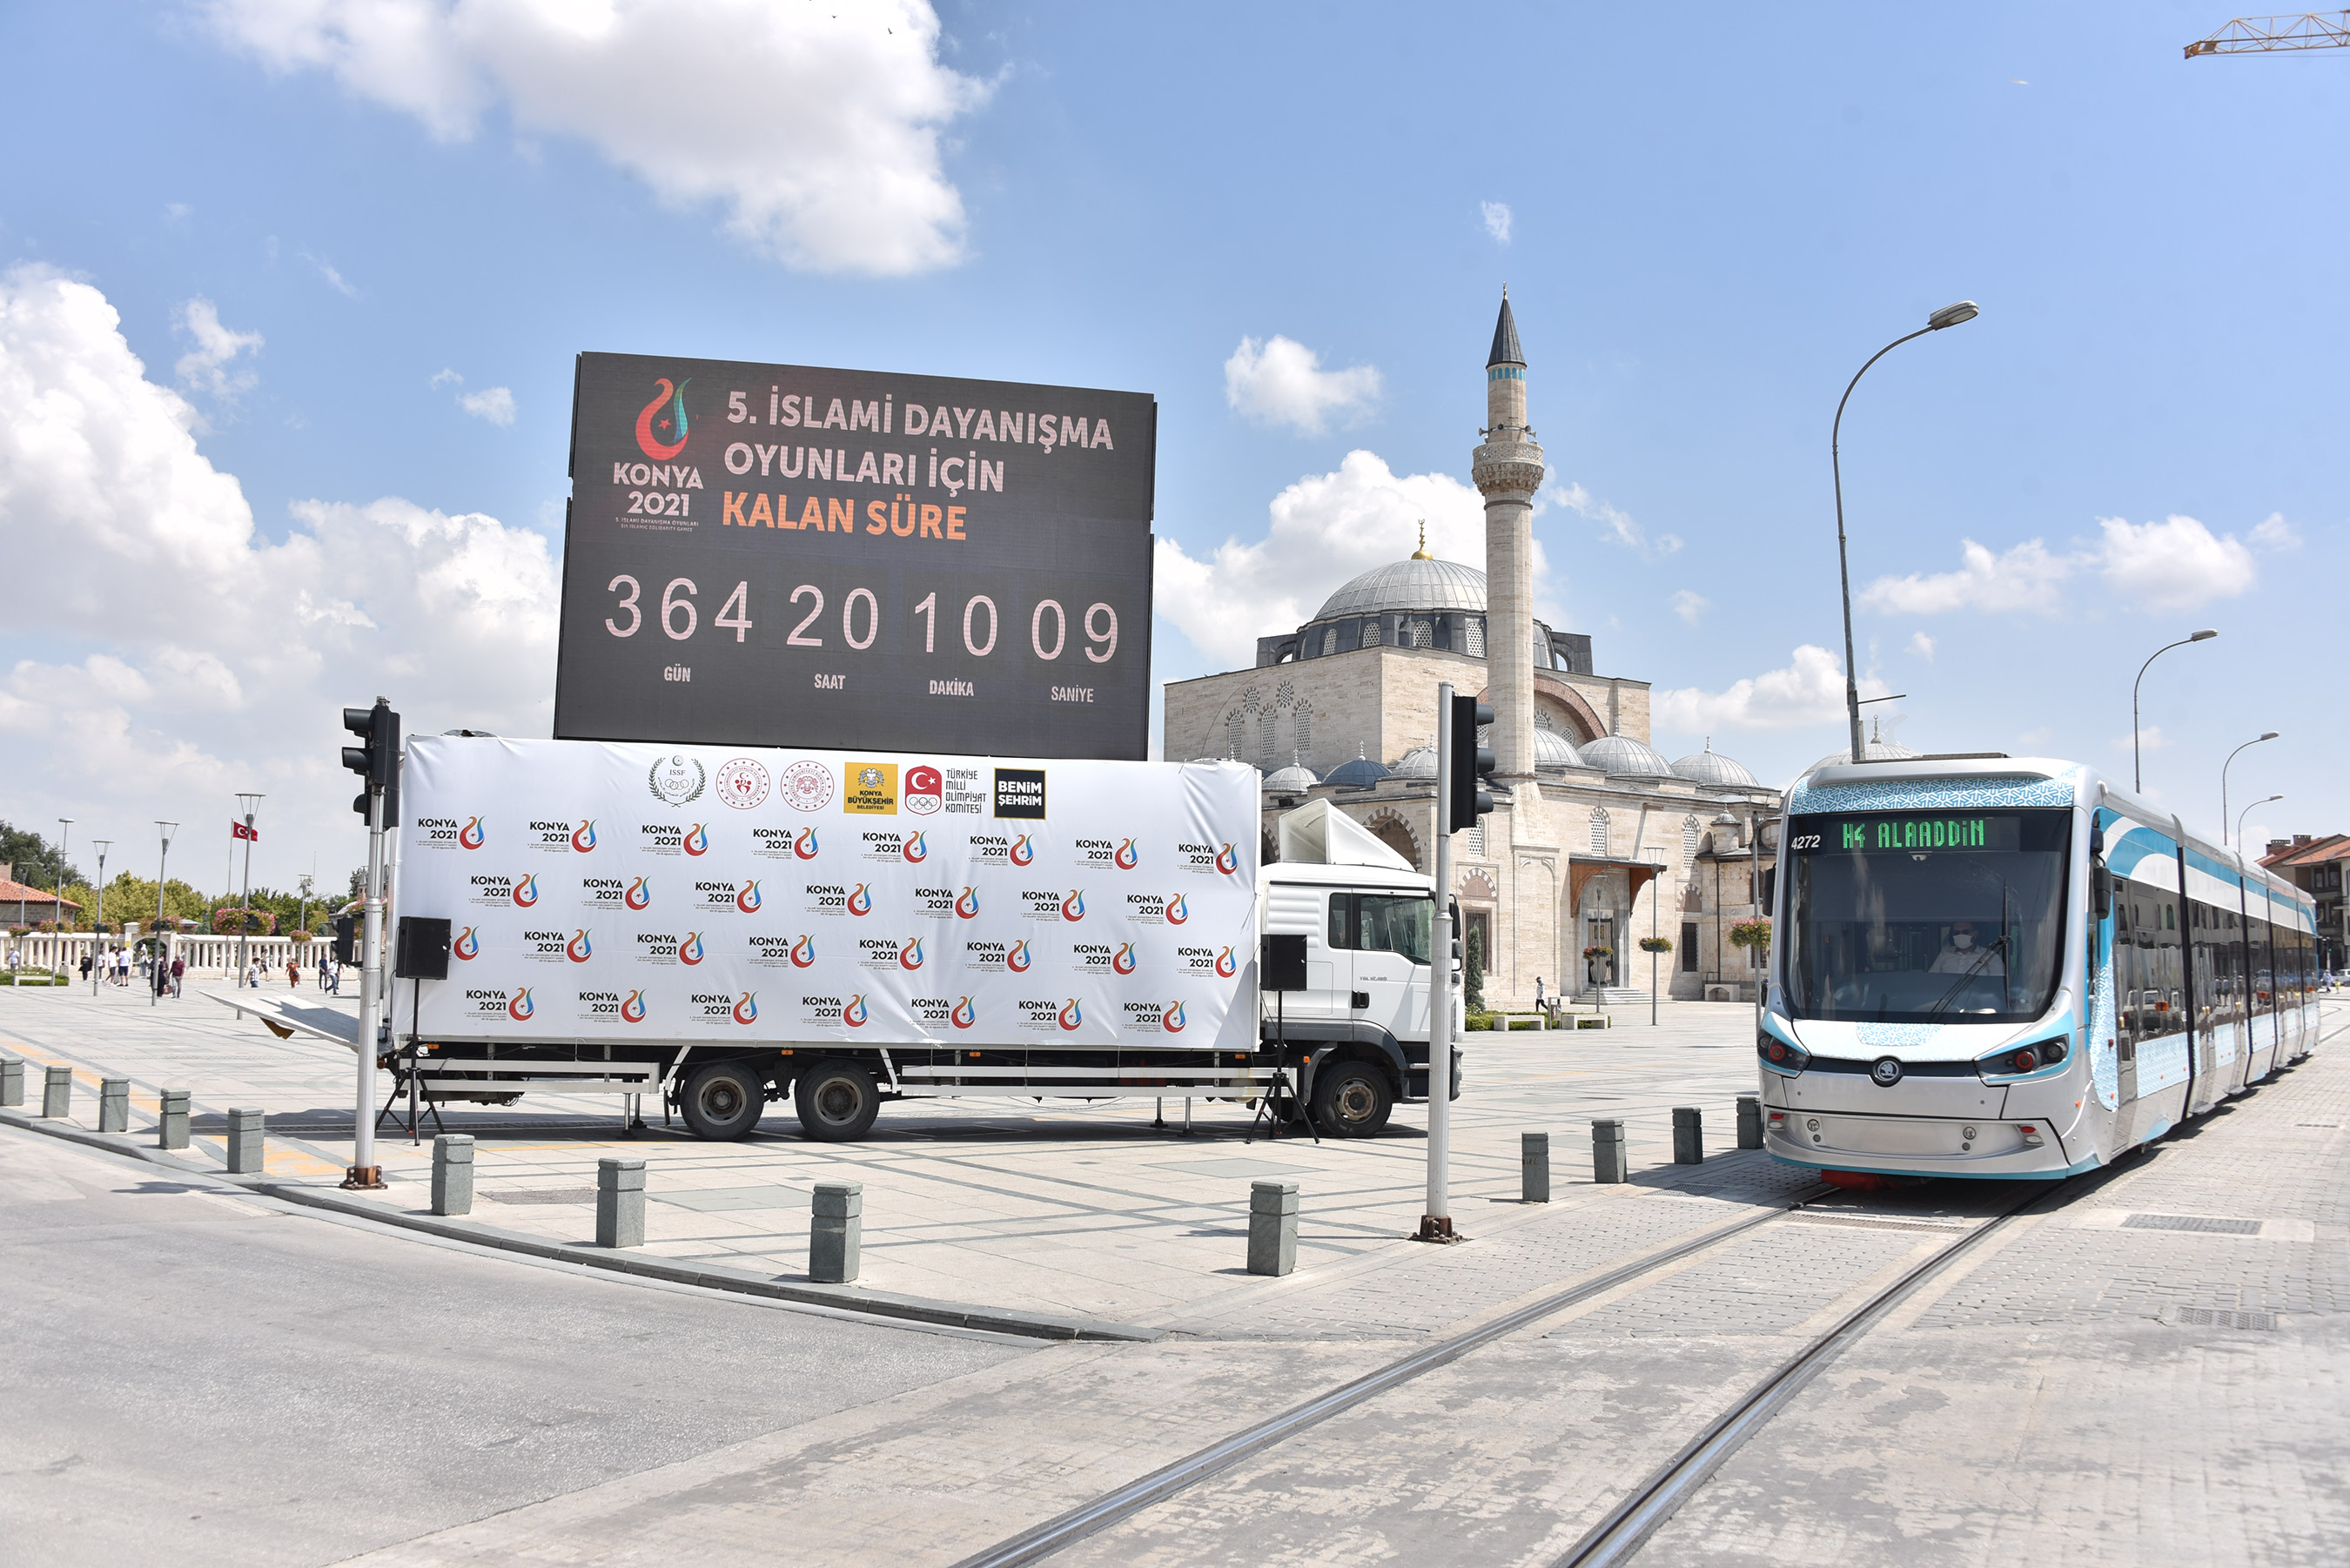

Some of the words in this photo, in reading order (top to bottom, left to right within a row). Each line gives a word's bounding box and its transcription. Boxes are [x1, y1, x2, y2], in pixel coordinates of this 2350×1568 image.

[727, 392, 756, 424] 5.
[769, 385, 892, 432] İSLAMİ
[905, 404, 1113, 454] DAYANIŞMA
[725, 442, 916, 486] OYUNLARI
[929, 448, 1004, 497] İÇİN
[613, 462, 703, 490] KONYA
[627, 491, 689, 516] 2021
[722, 492, 854, 533] KALAN
[866, 491, 966, 540] SÜRE
[787, 585, 878, 649] 20
[915, 593, 997, 656] 10
[1032, 600, 1118, 663] 09
[664, 664, 690, 681] GÜN
[815, 673, 845, 689] SAAT
[930, 678, 974, 696] DAKİKA
[1051, 685, 1093, 702] SANİYE
[946, 768, 978, 780] TÜRKİYE
[945, 780, 966, 791] MİLLİ
[847, 796, 894, 806] BÜYÜKŞEHİR
[945, 792, 987, 802] OLİMPİYAT
[945, 802, 982, 814] KOMİTESİ
[418, 818, 458, 828] KONYA
[529, 821, 570, 832] KONYA
[430, 829, 457, 840] 2021
[641, 825, 682, 835] KONYA
[753, 828, 793, 839] KONYA
[542, 833, 569, 842] 2021
[655, 836, 682, 846] 2021
[863, 832, 902, 842] KONYA
[970, 835, 1008, 846] KONYA
[1790, 834, 1821, 850] 4272
[765, 840, 792, 849] 2021
[875, 843, 901, 853] 2021
[1076, 839, 1113, 849] KONYA
[1178, 843, 1214, 854] KONYA
[982, 847, 1008, 856] 2021
[1087, 850, 1112, 860] 2021
[1190, 854, 1214, 865] 2021
[471, 875, 511, 886] KONYA
[583, 878, 623, 888] KONYA
[695, 881, 735, 892] KONYA
[806, 885, 845, 895] KONYA
[483, 887, 511, 897] 2021
[595, 890, 623, 900] 2021
[915, 888, 954, 898] KONYA
[1022, 891, 1060, 901] KONYA
[708, 893, 735, 903] 2021
[818, 896, 845, 906] 2021
[1127, 895, 1164, 904] KONYA
[927, 899, 953, 909] 2021
[1034, 902, 1060, 912] 2021
[1138, 905, 1164, 915] 2021
[524, 931, 565, 941] KONYA
[637, 934, 677, 944] KONYA
[749, 936, 789, 947] KONYA
[859, 939, 898, 949] KONYA
[967, 941, 1005, 952] KONYA
[537, 942, 564, 953] 2021
[649, 945, 677, 955] 2021
[1073, 944, 1111, 954] KONYA
[1178, 948, 1213, 957] KONYA
[762, 948, 789, 958] 2021
[871, 950, 897, 961] 2021
[978, 953, 1005, 962] 2021
[1085, 955, 1111, 965] 2021
[1189, 958, 1213, 968] 2021
[466, 989, 507, 1000] KONYA
[579, 992, 620, 1002] KONYA
[691, 994, 731, 1004] KONYA
[479, 1001, 507, 1011] 2021
[802, 996, 842, 1006] KONYA
[911, 998, 950, 1008] KONYA
[1018, 1001, 1057, 1010] KONYA
[592, 1003, 619, 1013] 2021
[703, 1005, 731, 1015] 2021
[1124, 1002, 1162, 1012] KONYA
[815, 1008, 842, 1017] 2021
[923, 1009, 950, 1019] 2021
[1031, 1011, 1057, 1021] 2021
[1135, 1014, 1161, 1023] 2021
